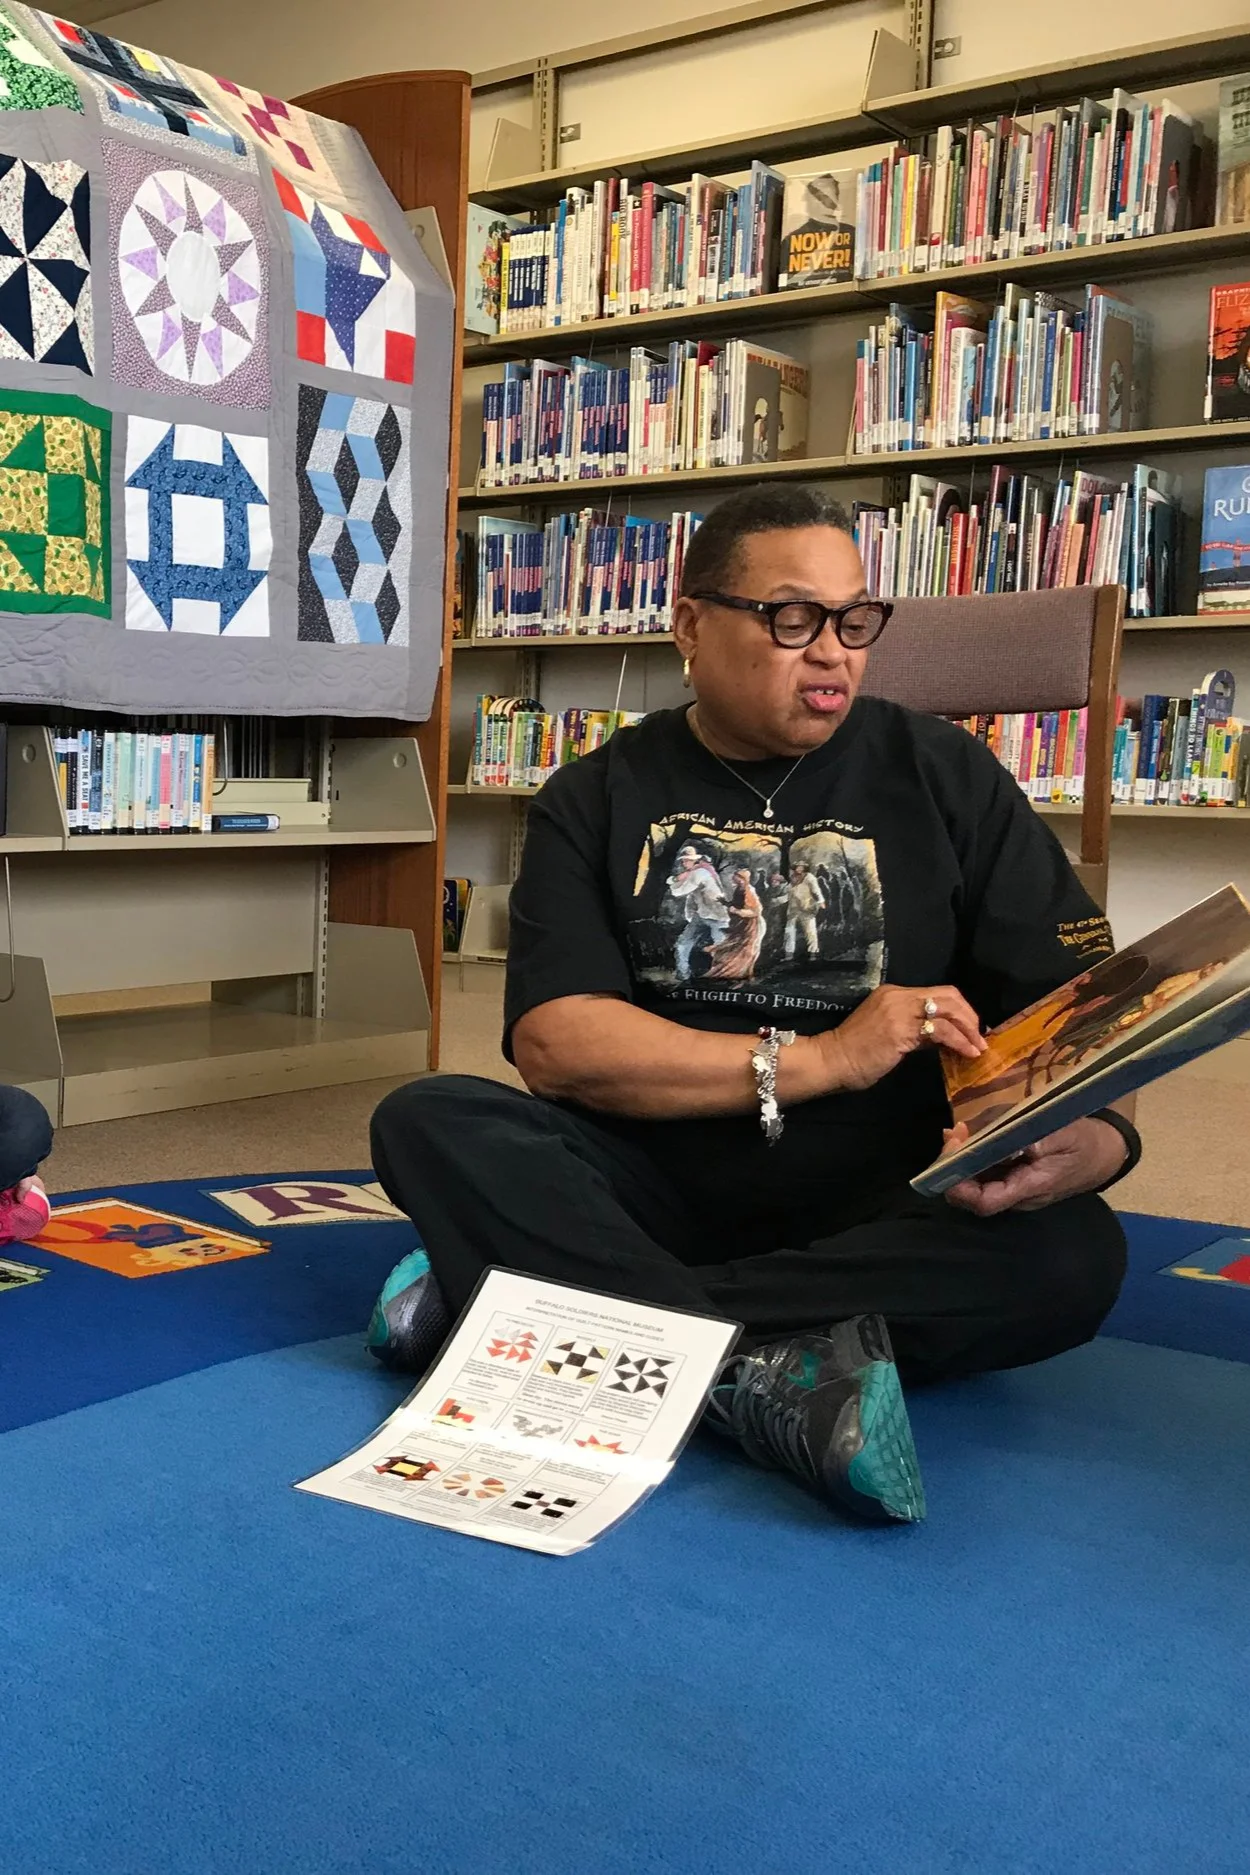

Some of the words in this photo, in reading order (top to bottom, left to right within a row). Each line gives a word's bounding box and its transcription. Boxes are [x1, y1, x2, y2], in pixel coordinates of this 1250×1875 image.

[791, 231, 834, 252] NOW
[836, 233, 850, 246] OR
[789, 249, 851, 272] NEVER!
[659, 812, 716, 825] AFRICAN
[724, 819, 794, 834] AMERICAN
[803, 818, 865, 834] HISTORY
[685, 988, 741, 1003] FLIGHT
[745, 992, 767, 1005] TO
[772, 993, 852, 1012] FREEDO
[232, 1184, 399, 1221] R
[535, 1298, 565, 1312] BUFFALO
[598, 1312, 633, 1327] NATIONAL
[633, 1320, 664, 1333] MUSEUM
